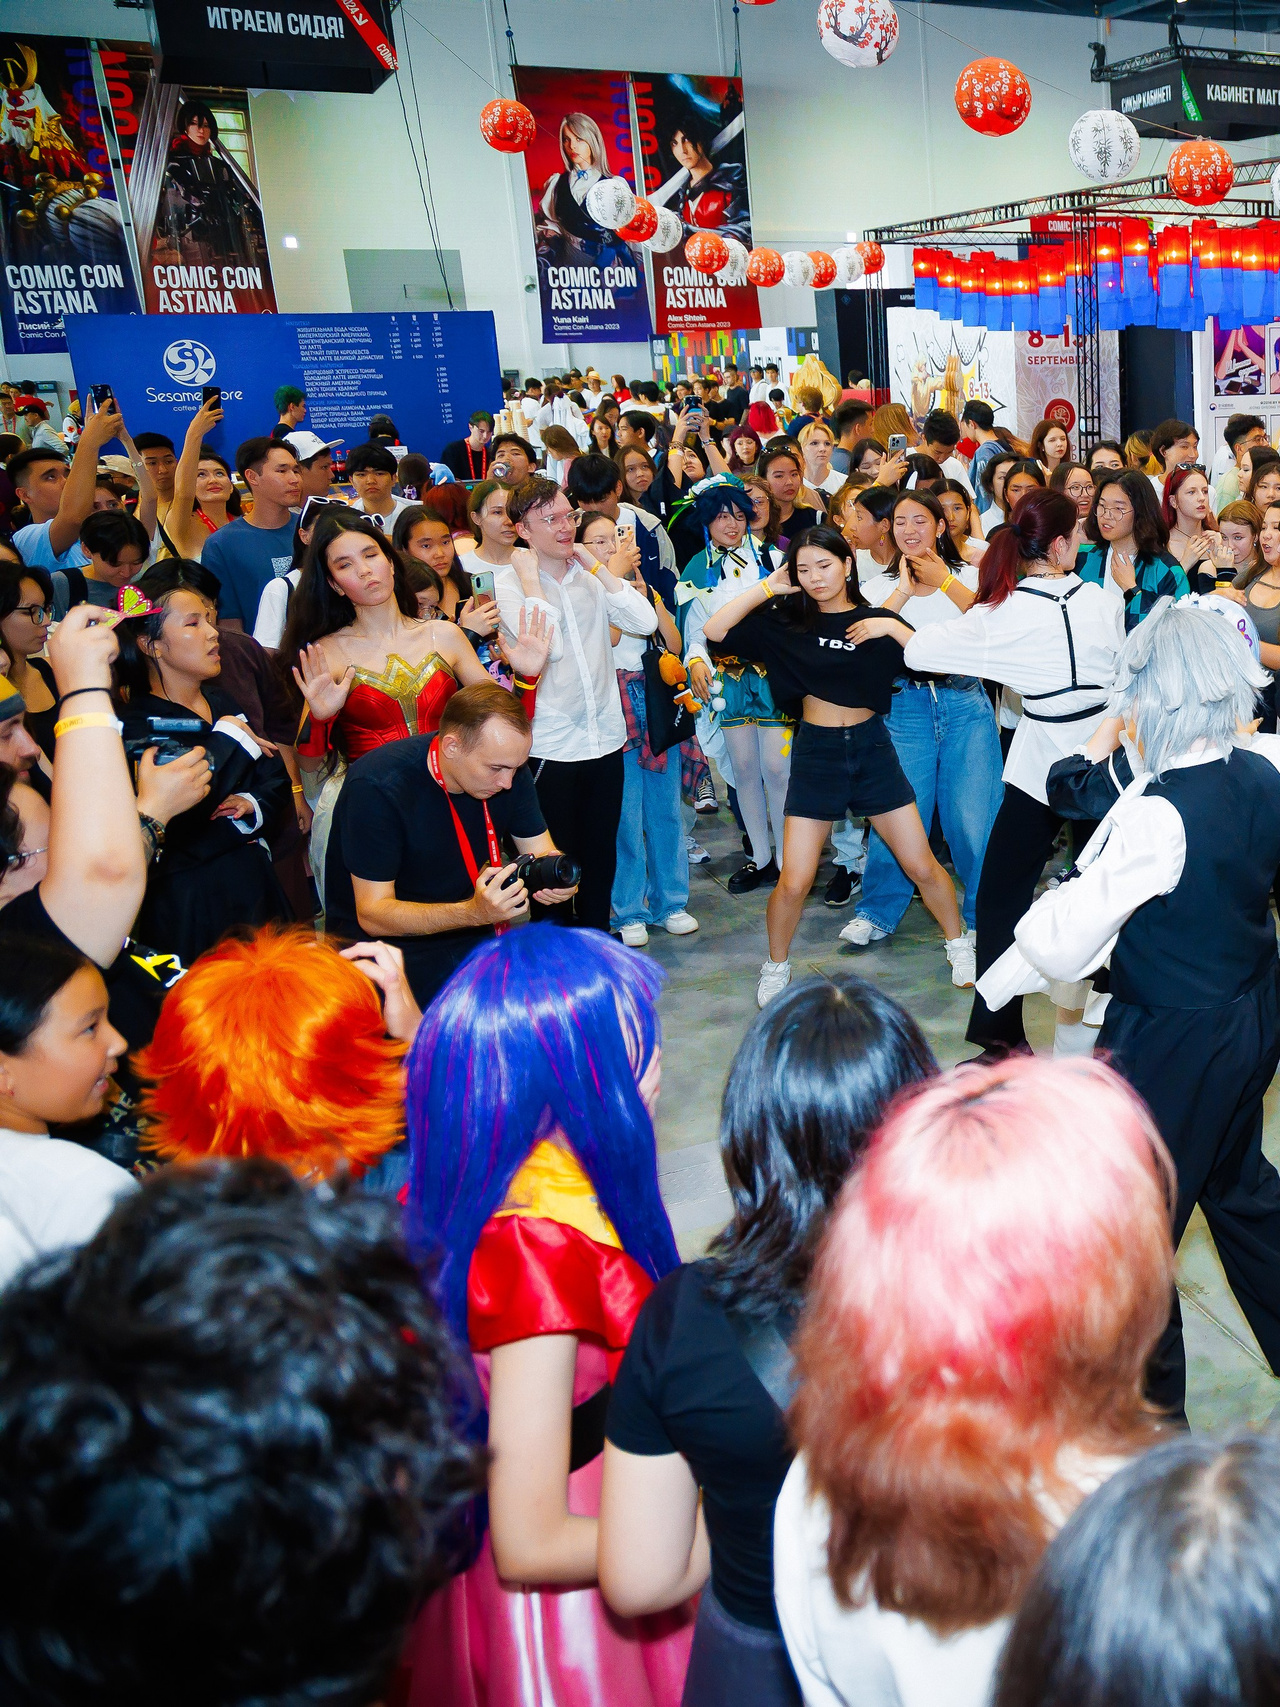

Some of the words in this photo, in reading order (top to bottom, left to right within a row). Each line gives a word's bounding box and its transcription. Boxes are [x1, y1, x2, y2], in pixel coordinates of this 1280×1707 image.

[207, 6, 283, 34] ИГРАЕМ
[287, 13, 344, 40] СИДЯ!
[1207, 84, 1254, 104] КАБИНЕТ
[1048, 220, 1070, 232] COMIC
[5, 265, 76, 288] COMIC
[81, 265, 124, 288] CON
[154, 265, 219, 289] COMIC
[223, 266, 263, 289] CON
[548, 266, 600, 288] COMIC
[604, 266, 637, 287] CON
[663, 266, 713, 287] COMIC
[14, 290, 98, 314] ASTANA
[159, 290, 237, 313] ASTANA
[551, 288, 616, 310] ASTANA
[666, 288, 727, 308] ASTANA
[18, 321, 50, 330] Лисий
[553, 316, 571, 324] Yuna
[146, 387, 202, 403] Sesame
